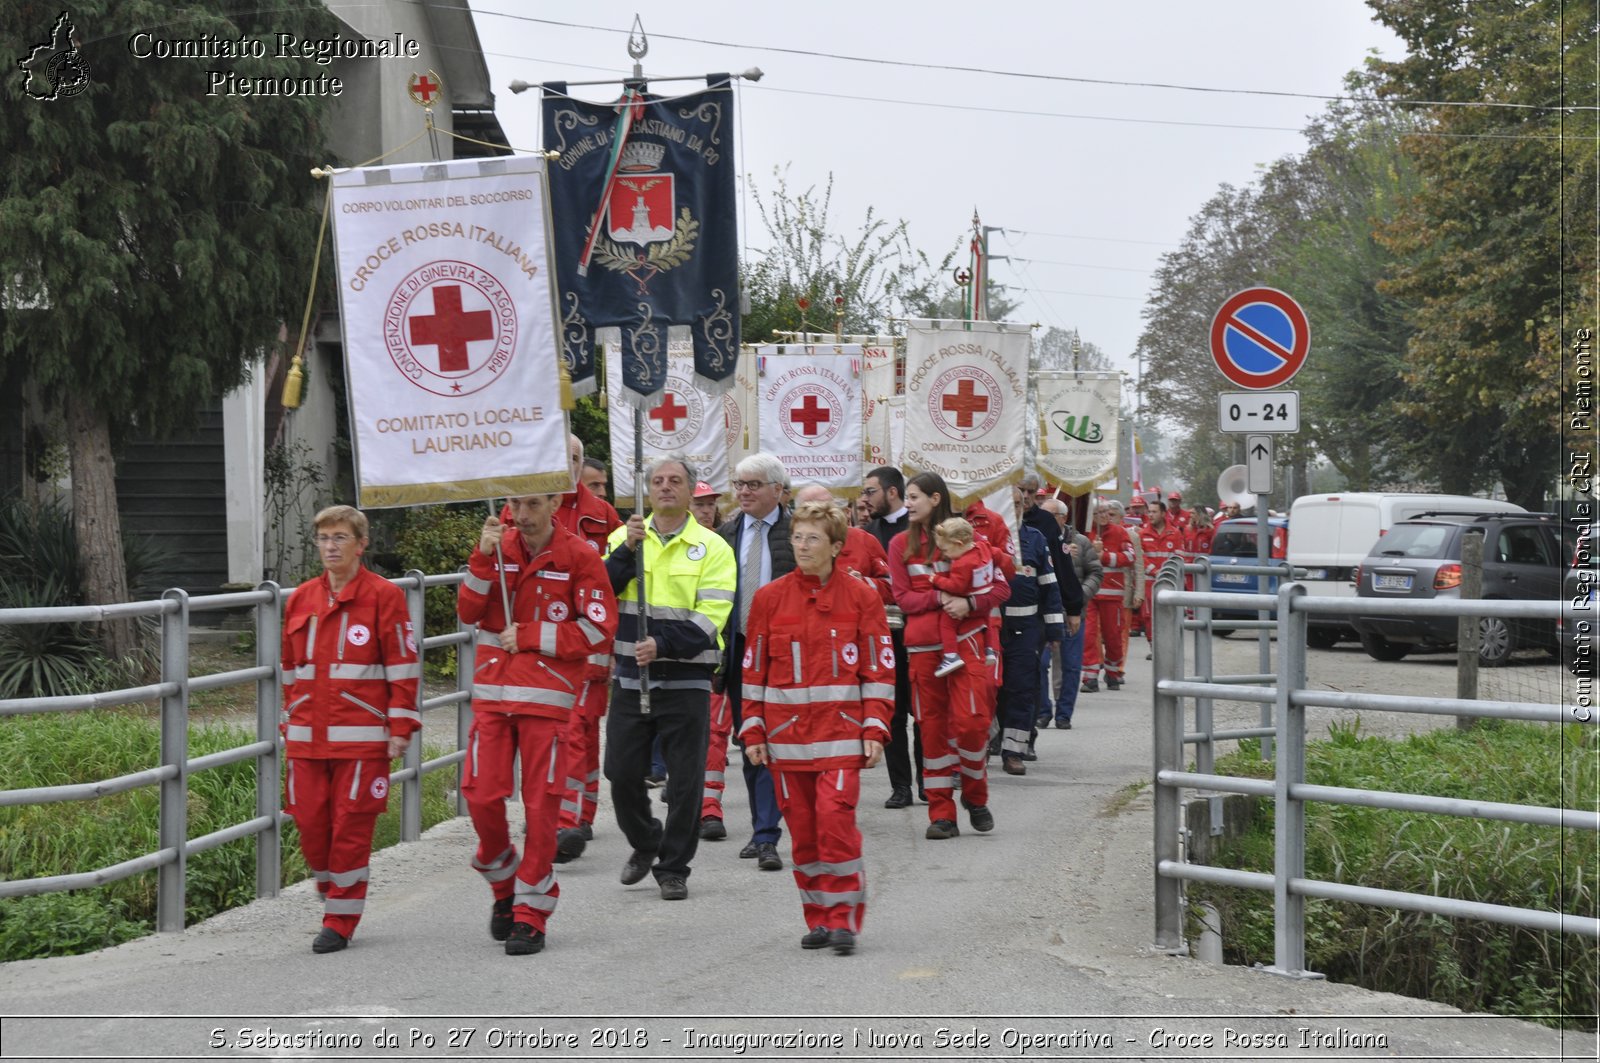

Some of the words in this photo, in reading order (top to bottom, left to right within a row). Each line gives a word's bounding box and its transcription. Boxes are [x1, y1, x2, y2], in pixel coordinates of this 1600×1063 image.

[559, 135, 597, 171] COMUNE
[596, 131, 609, 146] DI
[686, 135, 704, 152] DA
[703, 147, 720, 166] PO
[342, 201, 383, 214] CORPO
[386, 196, 446, 212] VOLONTARI
[448, 195, 469, 208] DEL
[470, 189, 533, 205] SOCCORSO
[349, 236, 403, 292] CROCE
[402, 222, 465, 247] ROSSA
[468, 223, 539, 281] ITALIANA
[406, 276, 421, 292] DI
[420, 265, 475, 283] GINEVRA
[477, 275, 495, 292] 22
[491, 290, 514, 346] AGOSTO
[387, 288, 423, 380] CONVENZIONE
[488, 348, 510, 374] 1864
[910, 353, 939, 392] CROCE
[939, 343, 983, 360] ROSSA
[985, 349, 1024, 398] ITALIANA
[952, 368, 984, 379] GINEVRA
[766, 374, 789, 402] CROCE
[790, 365, 818, 379] ROSSA
[820, 367, 855, 402] ITALIANA
[376, 413, 469, 433] COMITATO
[474, 406, 544, 426] LOCALE
[1230, 404, 1241, 421] 0
[1263, 403, 1288, 421] 24
[412, 430, 513, 454] LAURIANO
[921, 442, 970, 453] COMITATO
[971, 444, 1007, 454] LOCALE
[777, 455, 811, 464] MITATO
[812, 455, 846, 464] LOCALE
[908, 450, 959, 480] GASSINO
[961, 455, 1018, 480] TORINESE
[961, 456, 968, 464] DI
